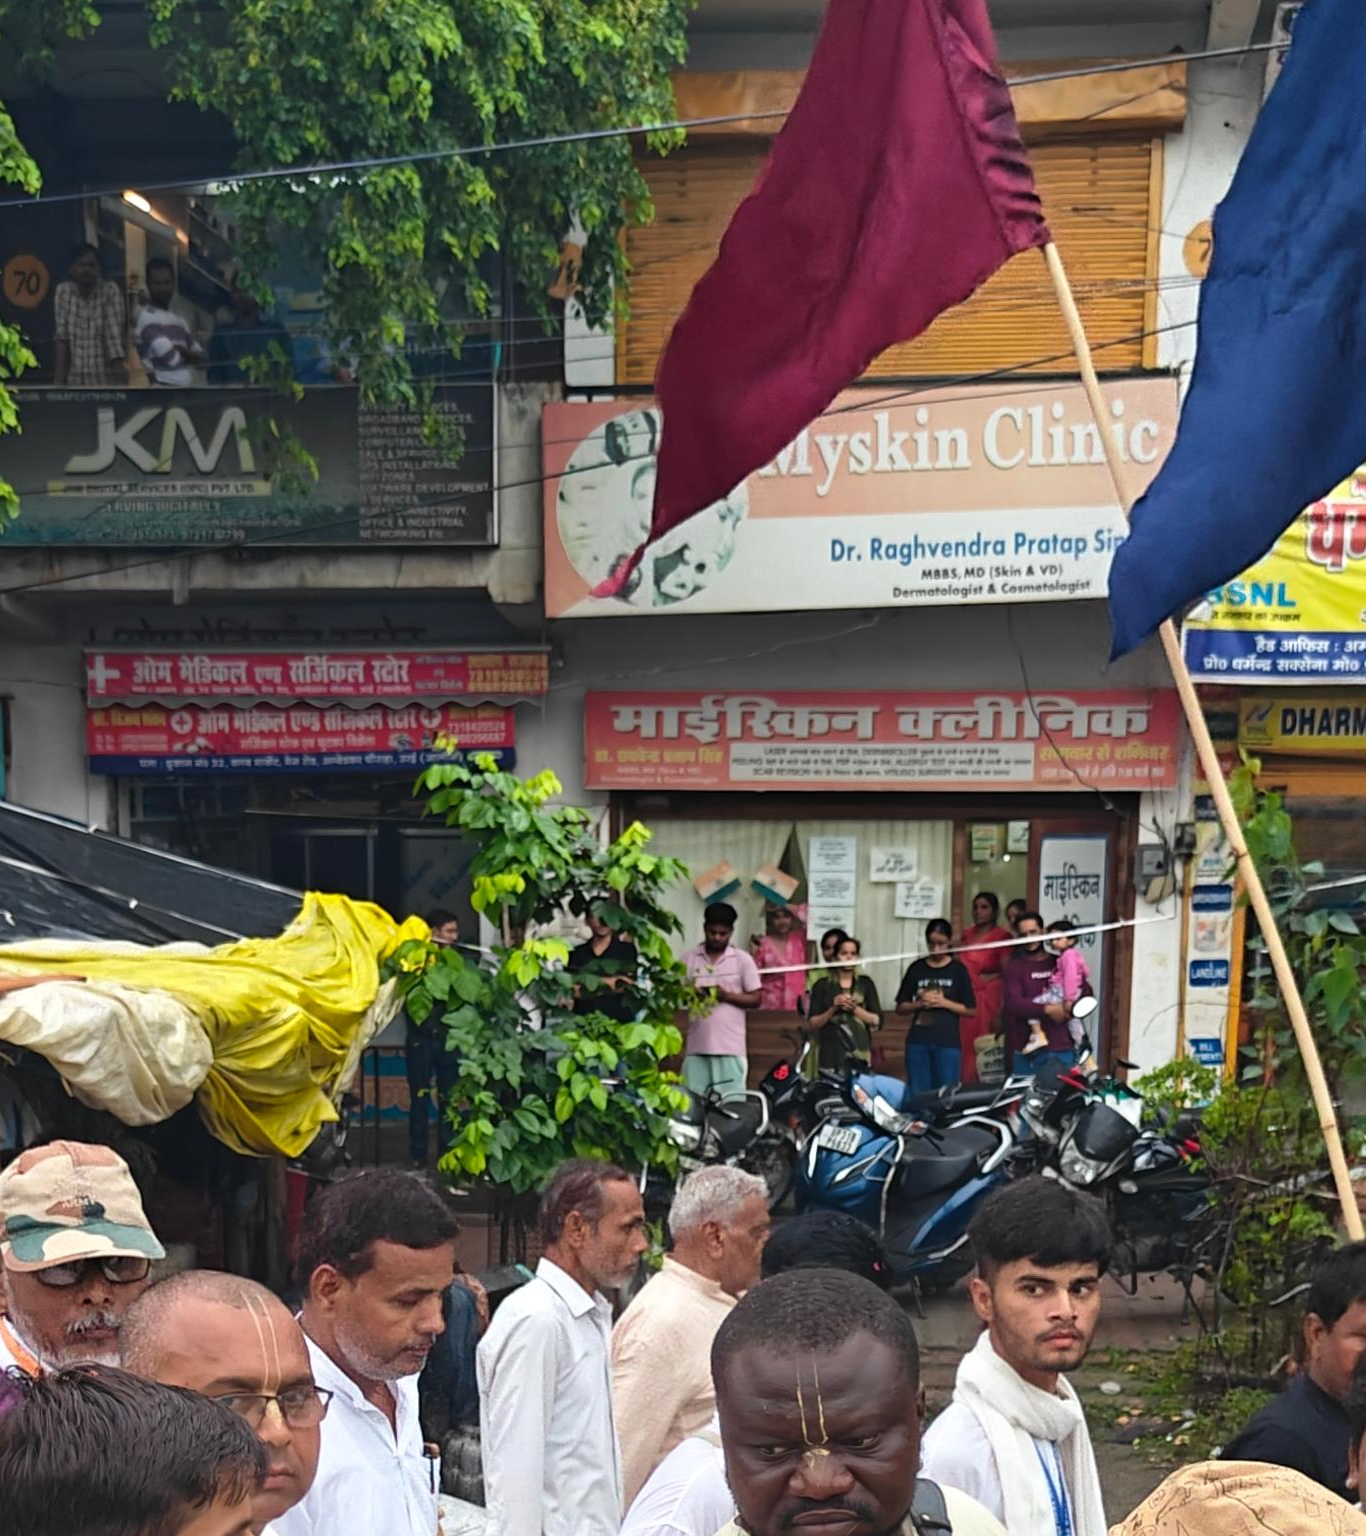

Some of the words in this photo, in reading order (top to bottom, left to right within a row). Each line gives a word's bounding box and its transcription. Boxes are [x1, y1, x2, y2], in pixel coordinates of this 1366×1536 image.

[12, 270, 41, 296] 70
[64, 405, 257, 474] JKM
[757, 406, 972, 498] Myskin
[830, 537, 863, 564] Dr.
[870, 533, 1008, 567] Raghvendra
[1013, 530, 1087, 562] Pratap
[891, 581, 983, 599] Dermatologist
[985, 581, 997, 596] &
[963, 565, 986, 580] MD
[988, 563, 1022, 581] (Skin
[1024, 564, 1035, 579] &
[1038, 562, 1064, 580] VD)
[610, 694, 880, 745] माईस्किन
[894, 695, 1154, 740] क्लीनिक
